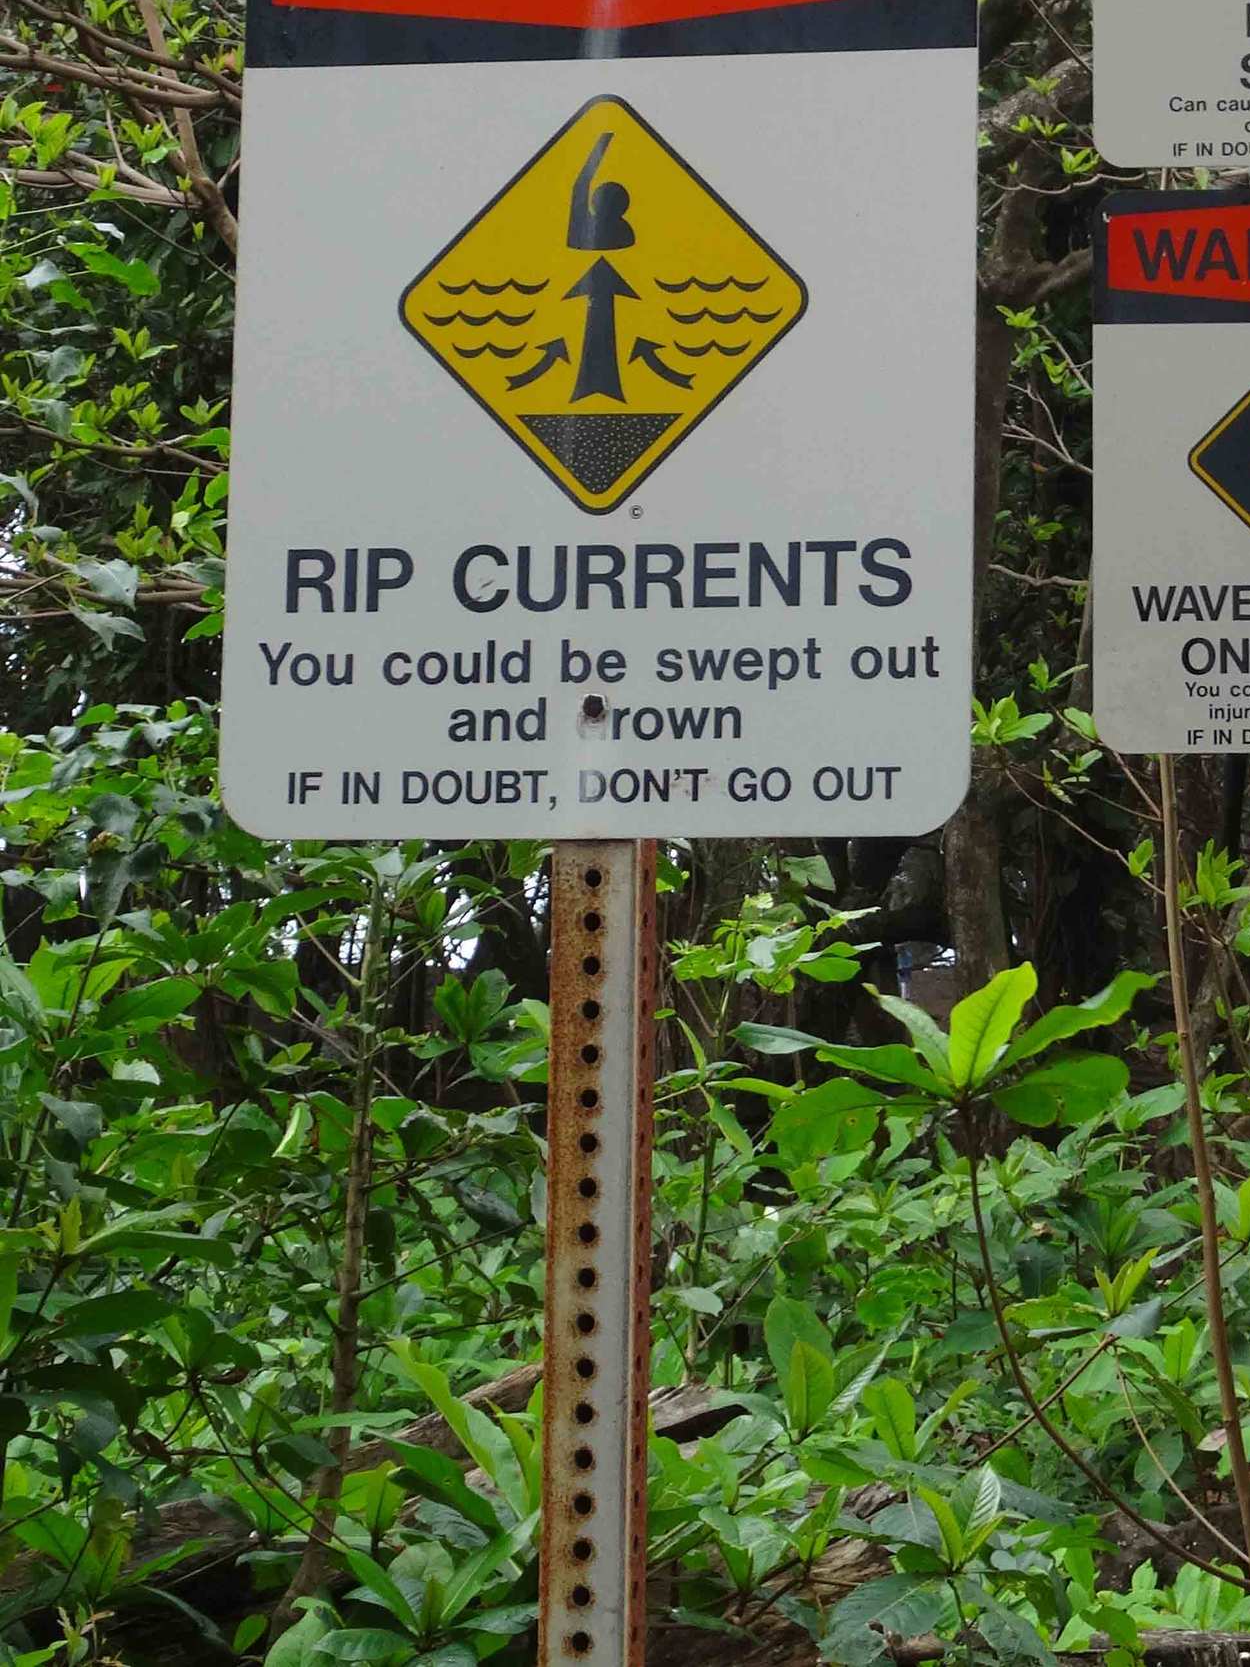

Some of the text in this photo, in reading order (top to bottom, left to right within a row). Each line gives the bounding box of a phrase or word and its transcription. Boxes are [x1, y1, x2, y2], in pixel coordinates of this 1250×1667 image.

[1169, 96, 1207, 112] Can
[1173, 143, 1187, 156] IF
[1196, 143, 1213, 156] IN
[285, 539, 913, 613] RIP CURRENTS
[259, 636, 940, 689] You could be swept out
[1181, 637, 1250, 675] ON
[1184, 682, 1220, 697] You
[448, 694, 741, 742] and rown
[1187, 730, 1204, 745] IF
[1213, 729, 1232, 745] IN
[288, 766, 901, 810] IF IN DOUBT, DON'T GO OUT
